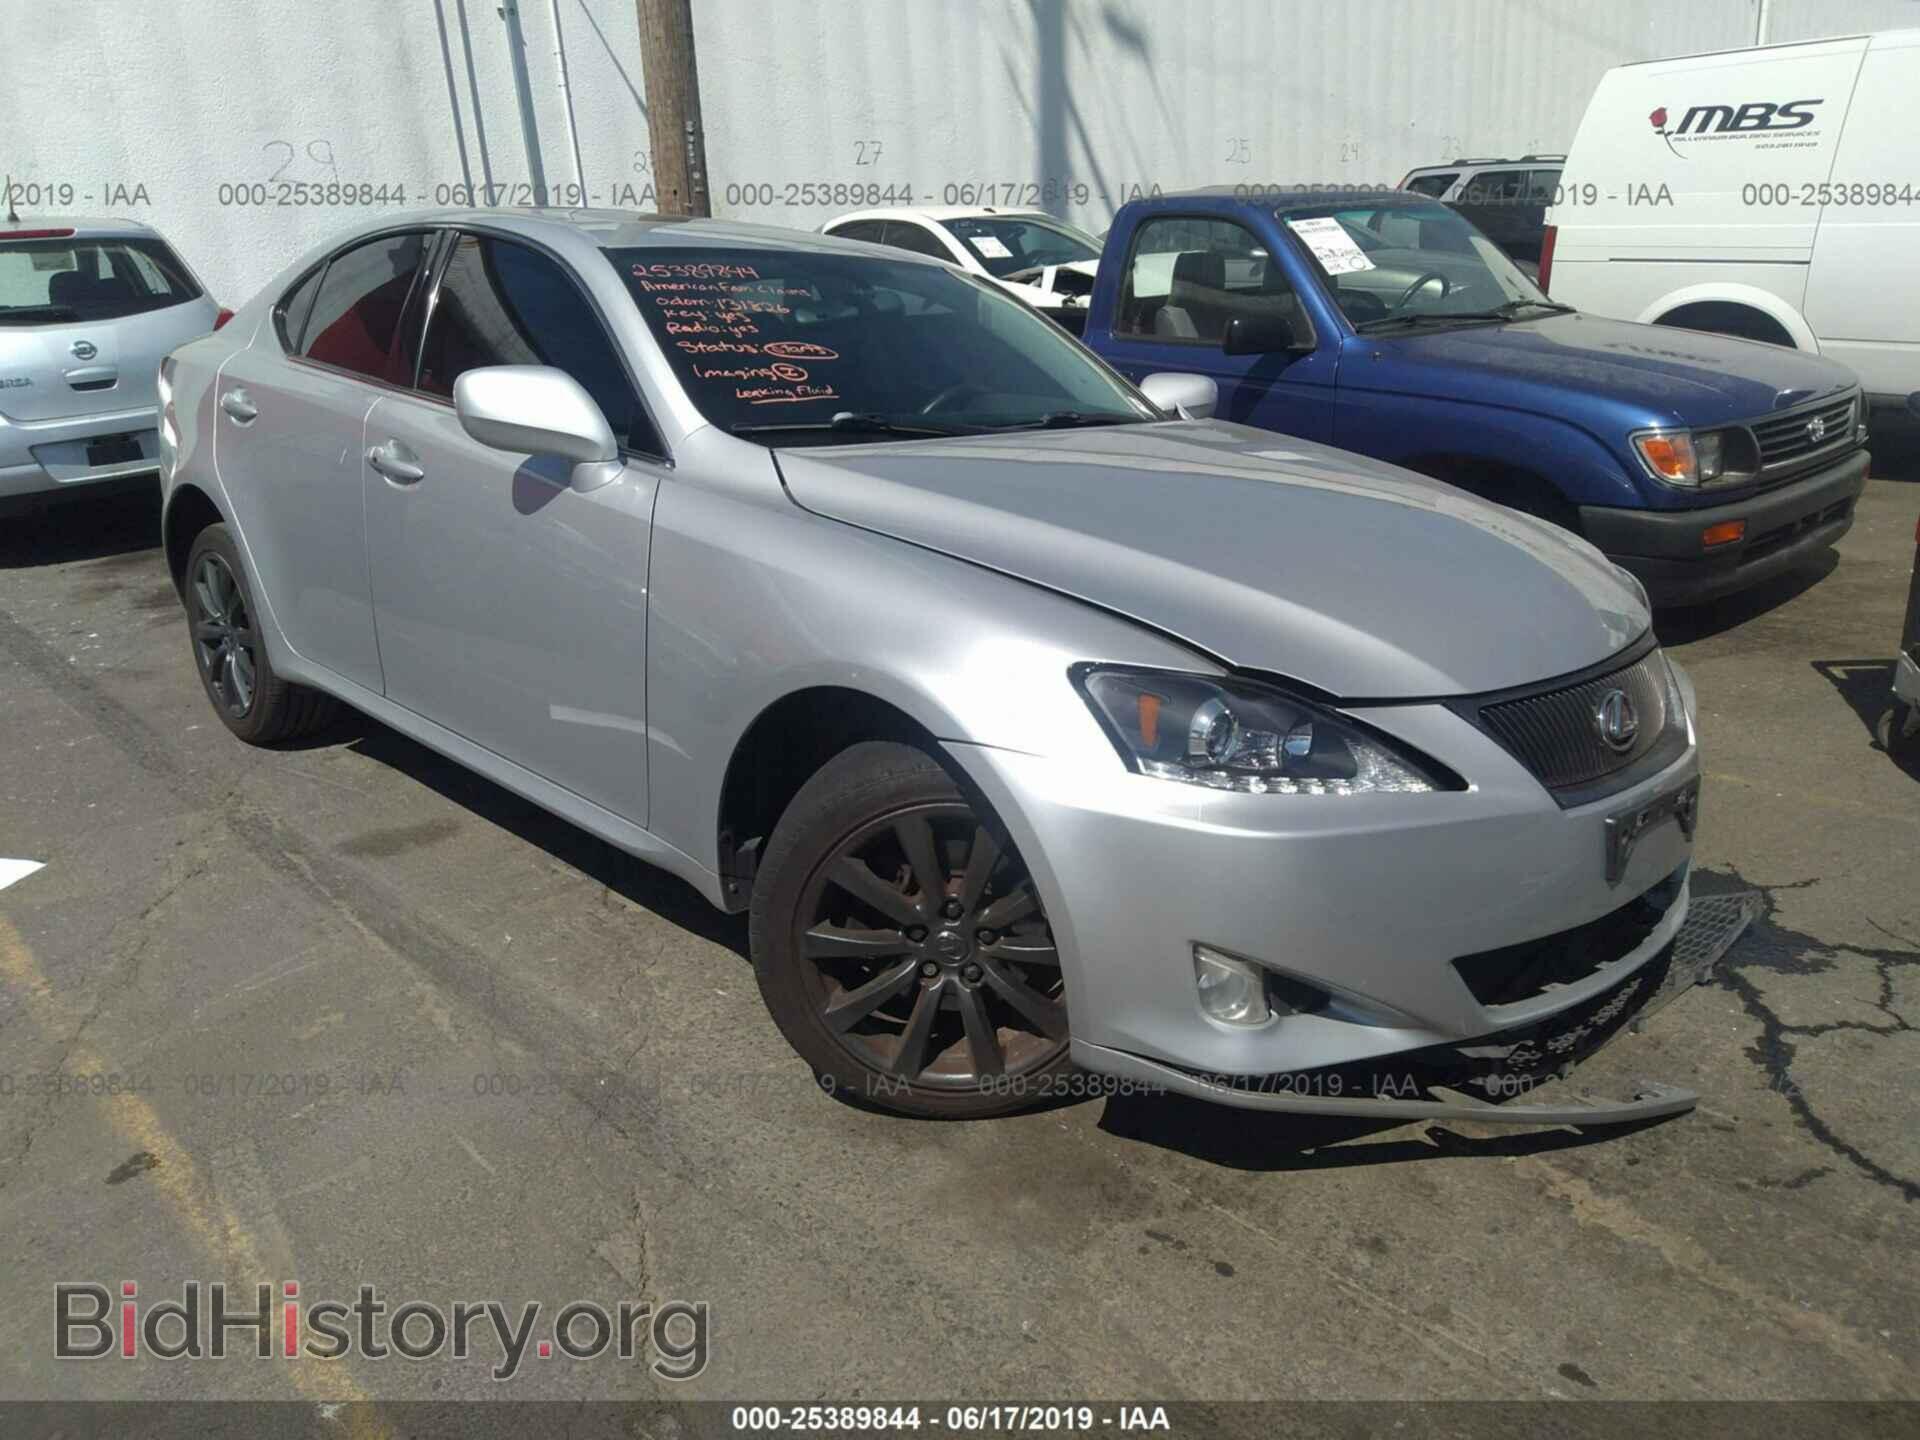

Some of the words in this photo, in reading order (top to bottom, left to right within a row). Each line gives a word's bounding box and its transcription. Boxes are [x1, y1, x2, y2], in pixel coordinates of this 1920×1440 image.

[1675, 98, 1825, 135] MBS
[262, 140, 339, 184] 29
[852, 140, 883, 166] 27
[1225, 138, 1251, 164] 25
[632, 264, 759, 279] 25389844
